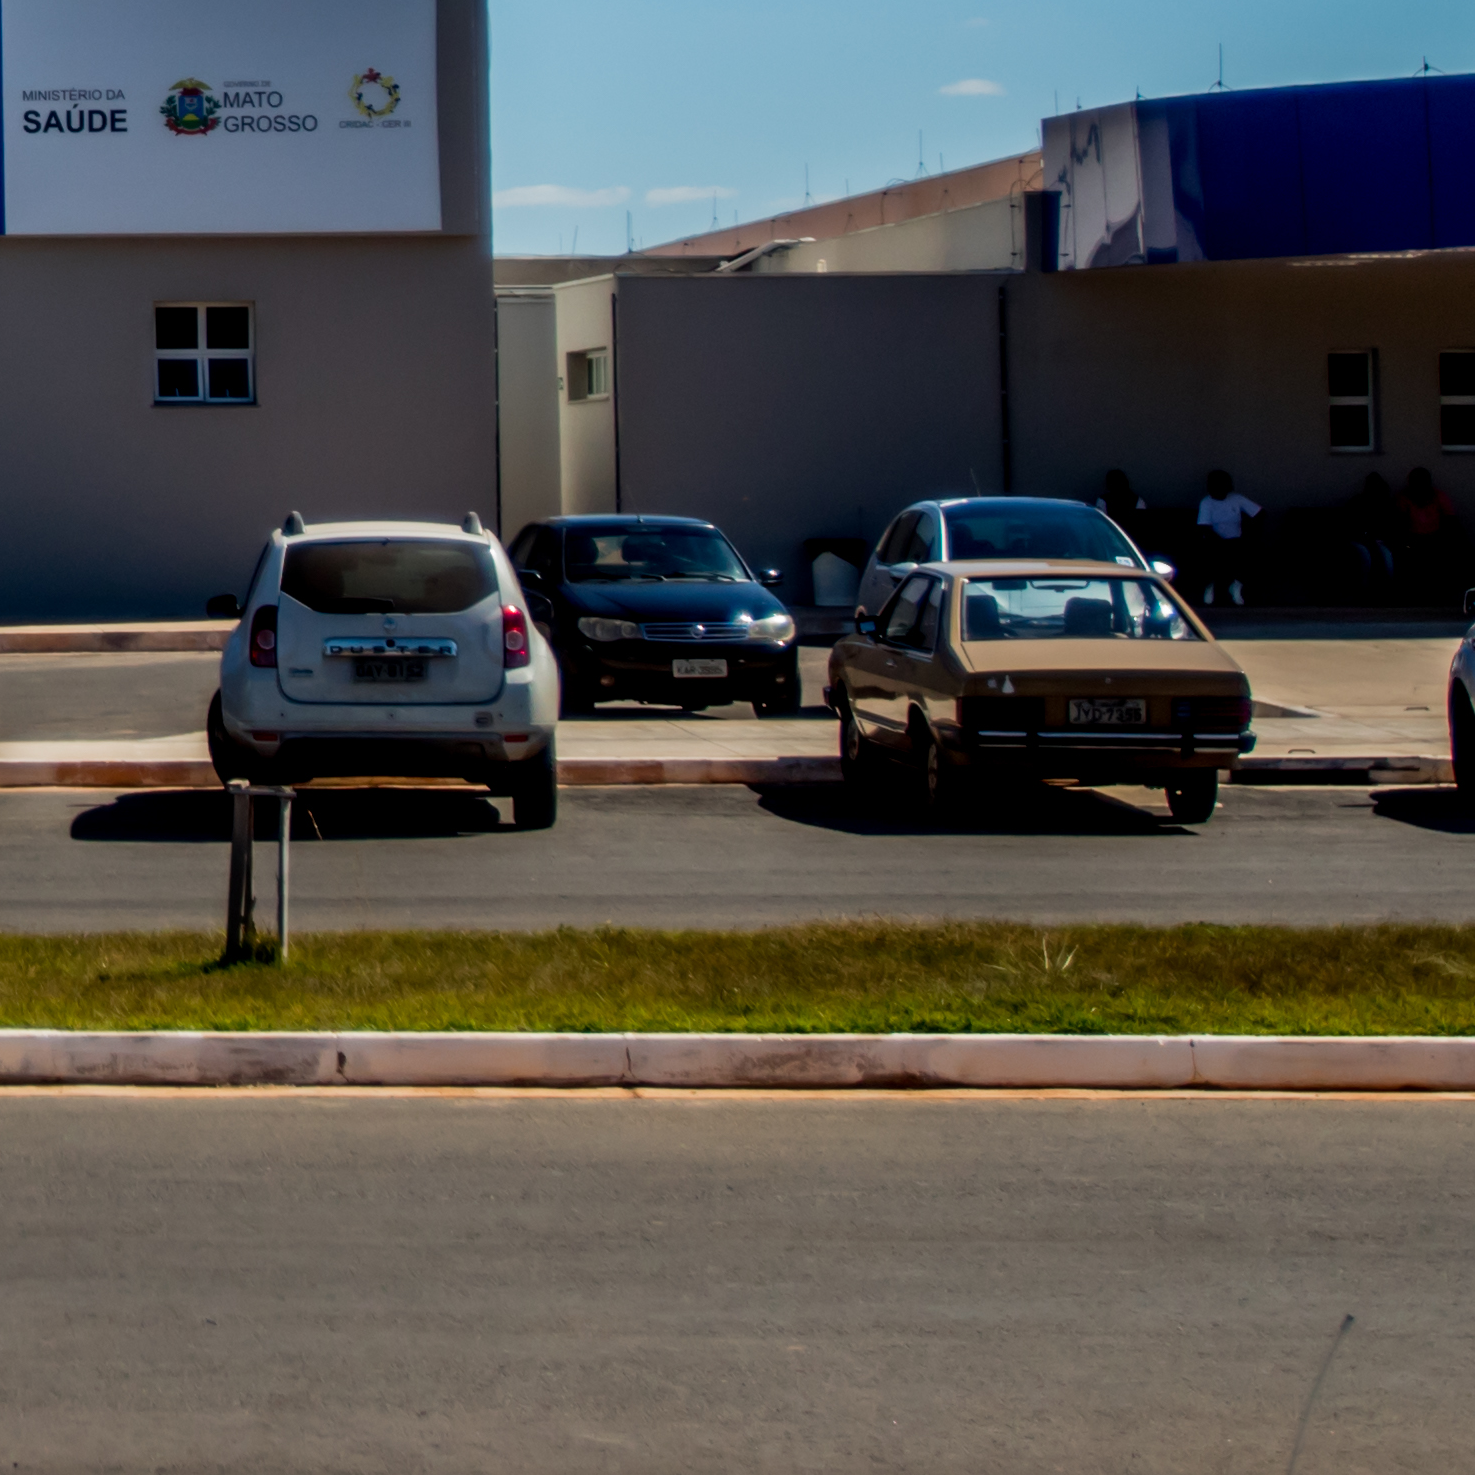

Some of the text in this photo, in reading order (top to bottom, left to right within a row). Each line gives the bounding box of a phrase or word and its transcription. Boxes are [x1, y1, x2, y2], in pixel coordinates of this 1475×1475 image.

[22, 87, 126, 102] MINISTÉRIO DA
[223, 91, 283, 108] MATO
[22, 103, 129, 135] SAÚDE
[223, 115, 318, 133] GROSSO
[329, 644, 453, 654] DUSTER
